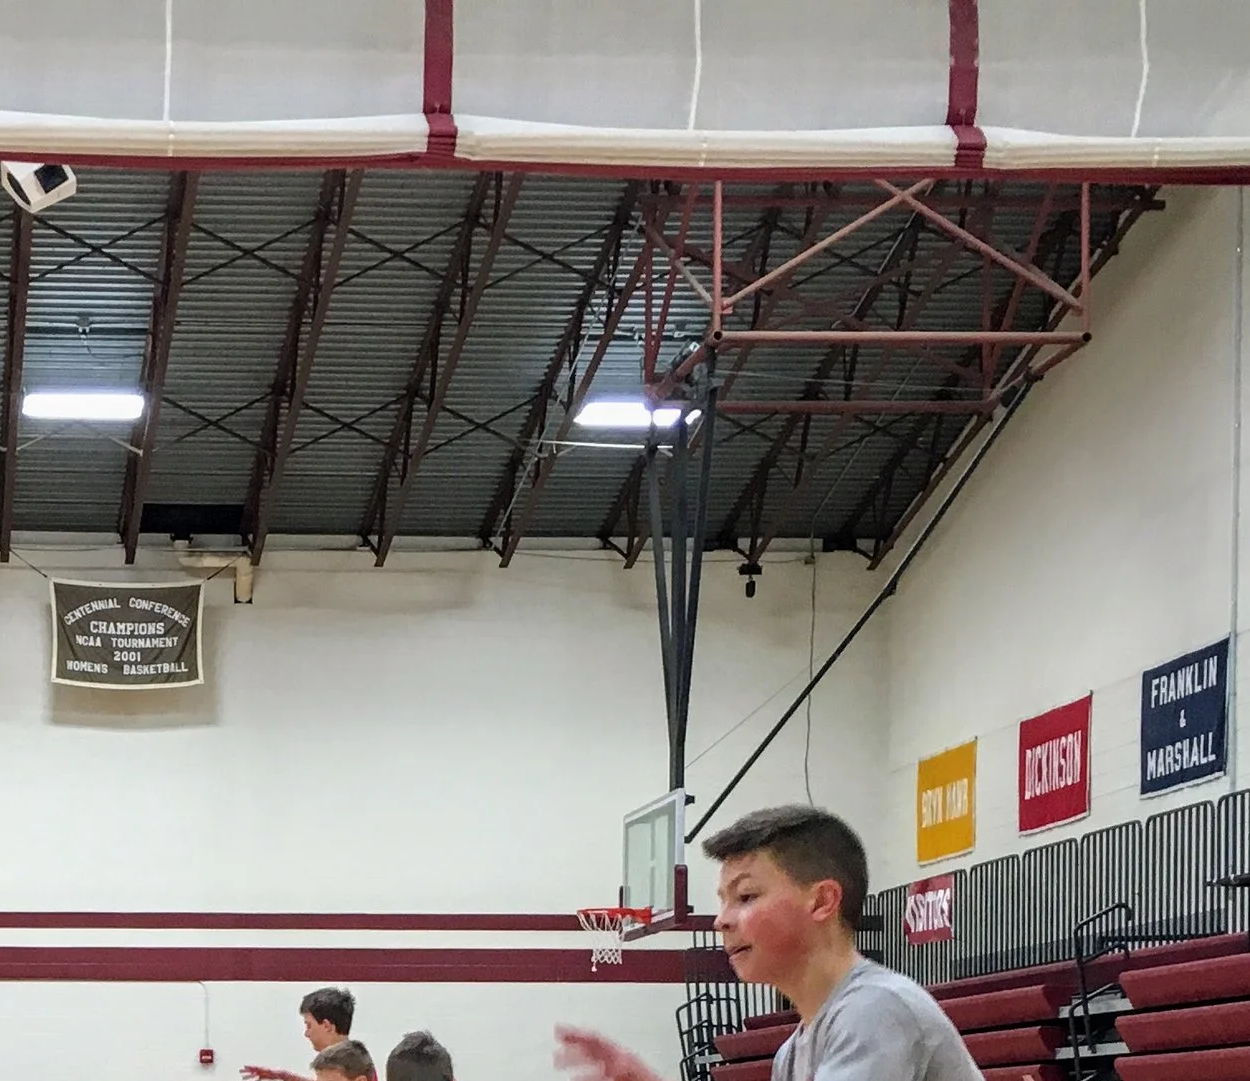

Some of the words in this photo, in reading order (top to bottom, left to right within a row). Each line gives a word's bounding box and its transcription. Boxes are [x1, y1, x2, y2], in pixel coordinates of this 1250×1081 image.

[64, 598, 121, 626] CENTENNIAL
[129, 597, 191, 628] CONFERENCE
[90, 621, 165, 635] CHAMPIONS
[76, 635, 102, 647] NCAA
[111, 636, 179, 649] TOURNAMENT
[113, 651, 141, 662] 2001
[66, 660, 109, 674] WOMENS
[122, 661, 189, 675] BASKETBALL
[1150, 655, 1218, 709] FRANKLIN
[1179, 709, 1187, 728] &
[1025, 730, 1081, 800] DICKINSON
[1146, 732, 1216, 781] MARSHALL
